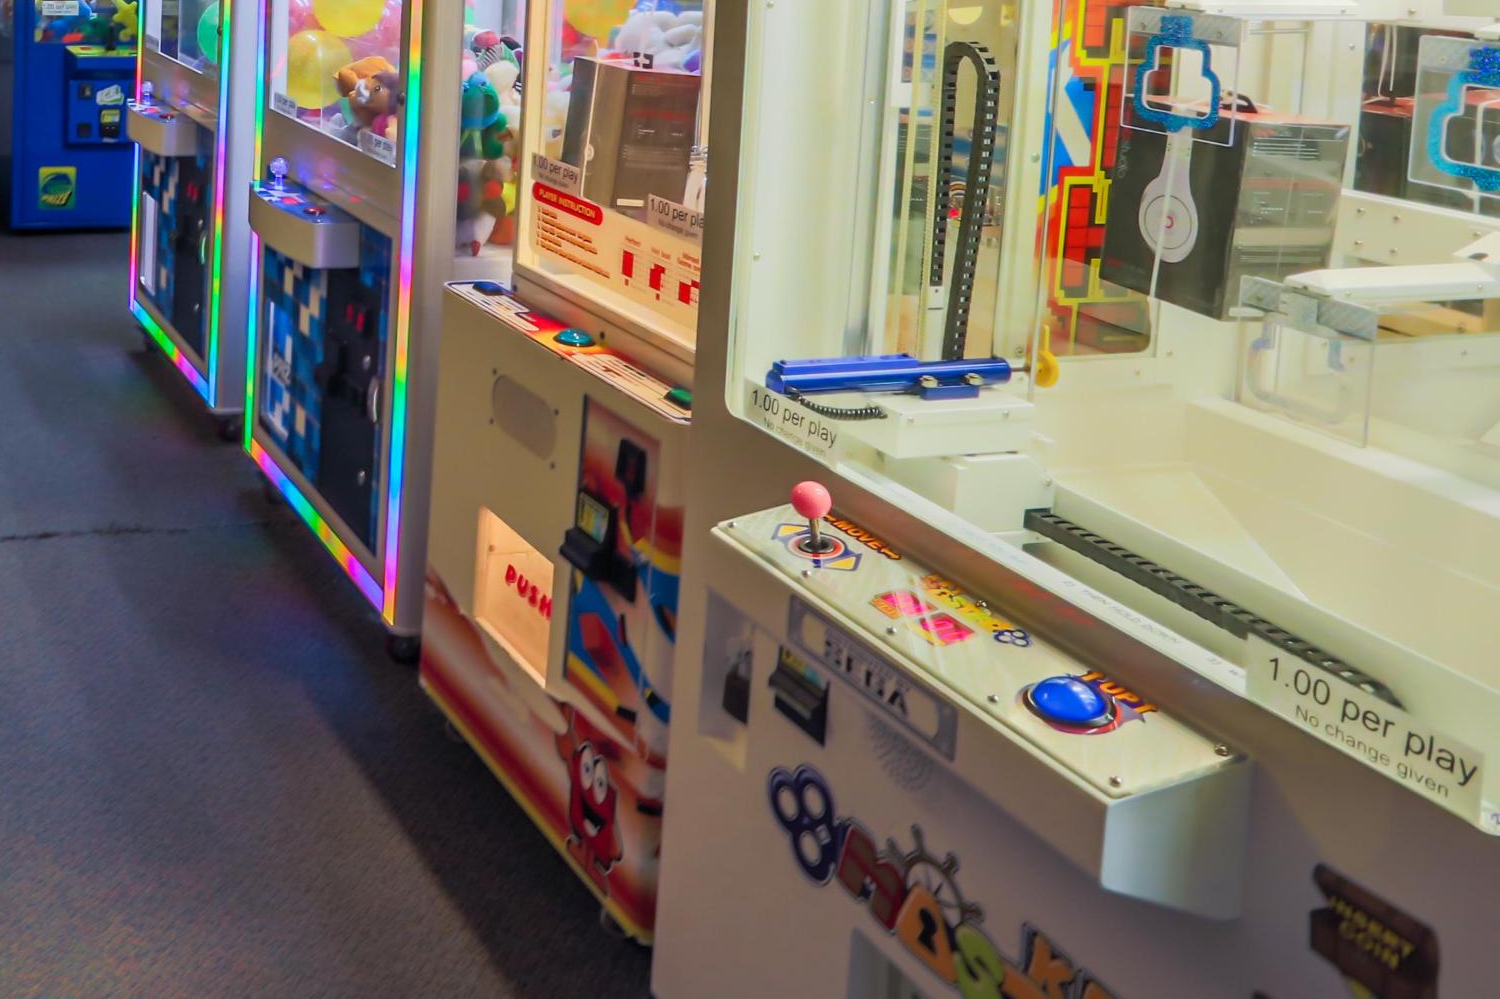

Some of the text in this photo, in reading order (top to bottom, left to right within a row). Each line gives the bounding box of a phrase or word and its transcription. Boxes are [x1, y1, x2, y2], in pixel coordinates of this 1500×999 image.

[550, 162, 561, 175] per
[562, 164, 579, 185] play
[651, 198, 670, 217] 1.00
[672, 207, 688, 223] per
[752, 388, 837, 449] 1.00 per play
[831, 518, 885, 553] MOVE
[504, 563, 553, 622] PUSH
[1269, 657, 1478, 787] 1.00 per play
[1295, 704, 1450, 799] No change given
